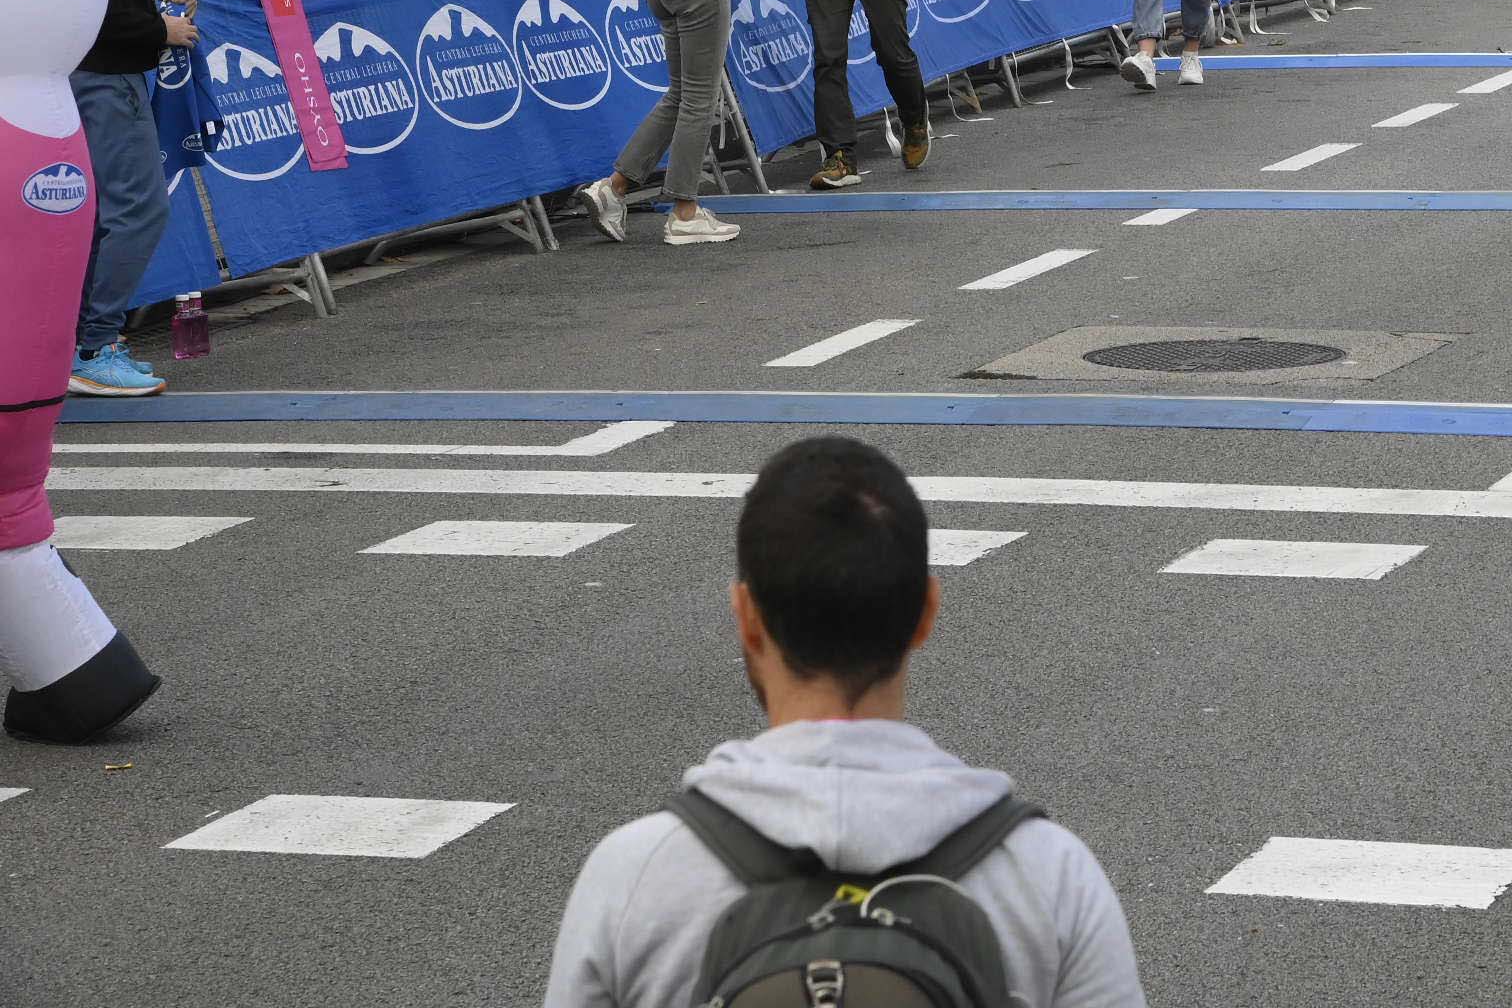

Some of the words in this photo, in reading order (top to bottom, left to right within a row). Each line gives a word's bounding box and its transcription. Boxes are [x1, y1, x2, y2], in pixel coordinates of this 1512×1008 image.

[437, 46, 466, 64] CENTRAL
[467, 42, 503, 58] LECHERA
[530, 32, 558, 47] CENTRAL
[559, 28, 591, 42] LECHERA
[325, 67, 359, 85] CENTRAL
[361, 59, 398, 76] LECHERA
[426, 55, 518, 103] ASTURIANA
[521, 40, 607, 85] ASTURIANA
[216, 89, 248, 107] ENTRAL
[294, 52, 329, 147] OYSHO
[330, 78, 414, 125] STURIANA
[216, 102, 300, 152] STURIANA
